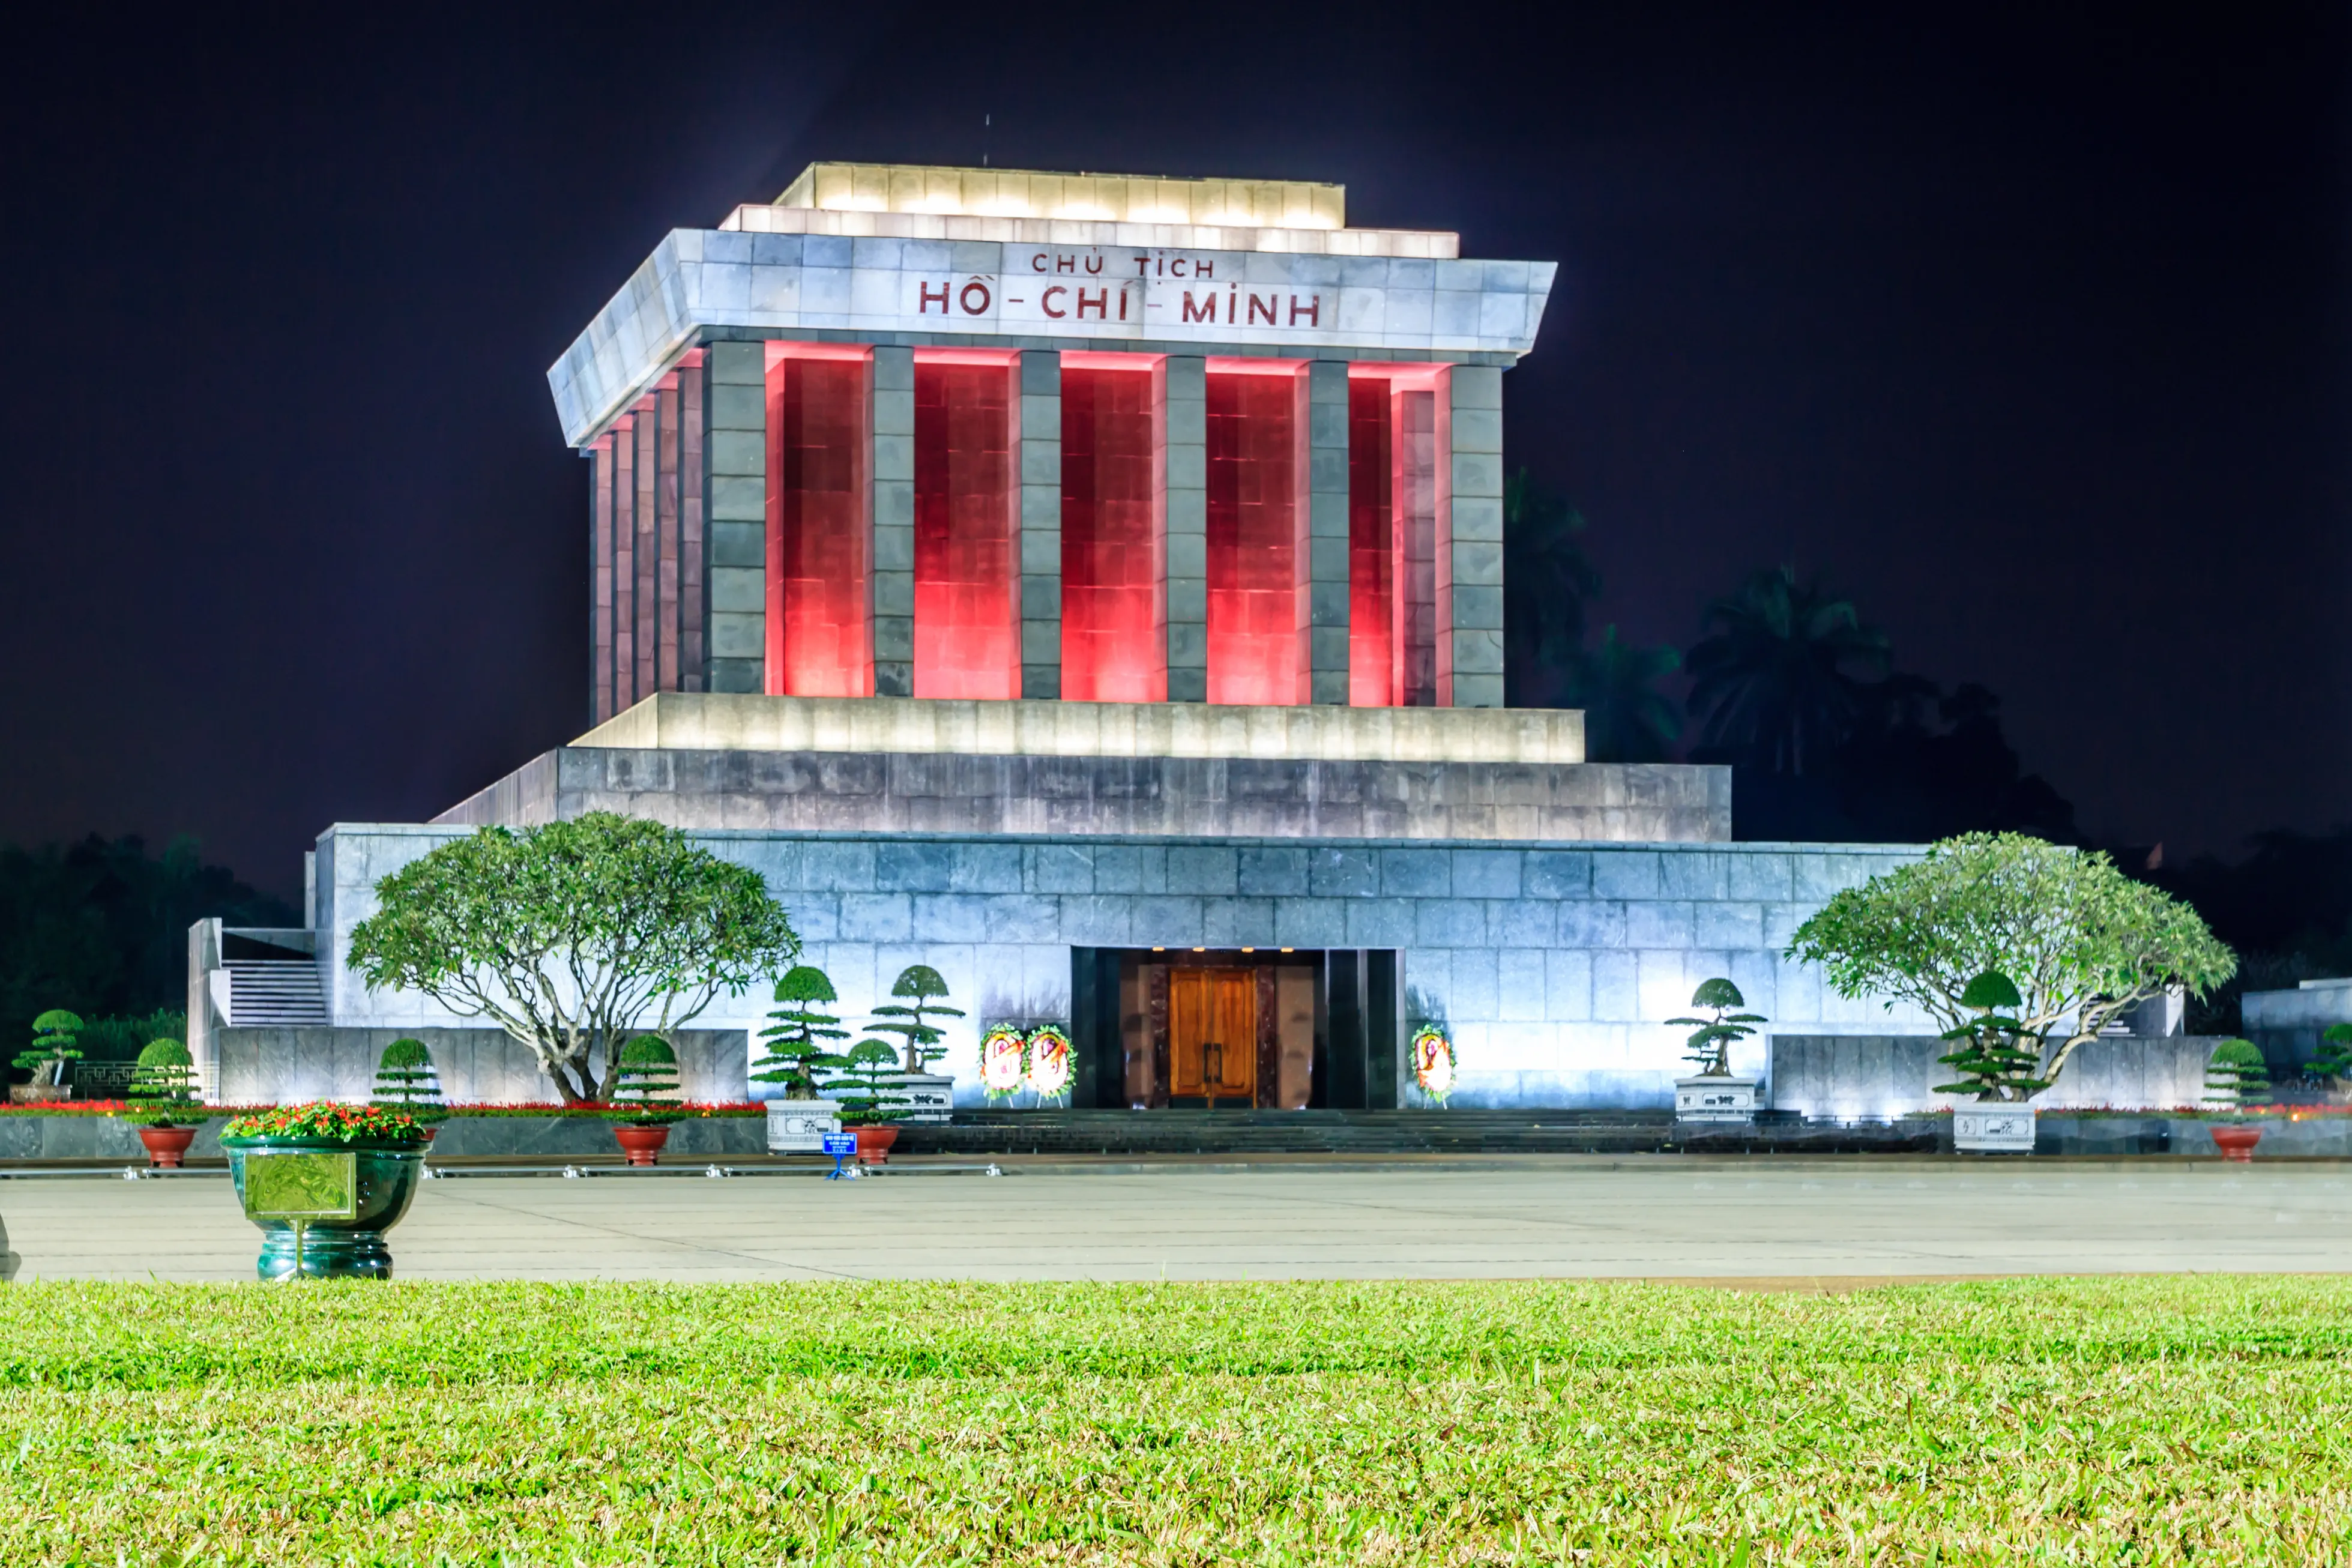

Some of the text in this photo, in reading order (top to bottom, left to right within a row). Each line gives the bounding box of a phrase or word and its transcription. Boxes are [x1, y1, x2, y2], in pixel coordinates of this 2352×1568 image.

[1031, 247, 1103, 274] CHỦ
[919, 275, 995, 316] HỒ
[1041, 280, 1133, 321] CHÍ
